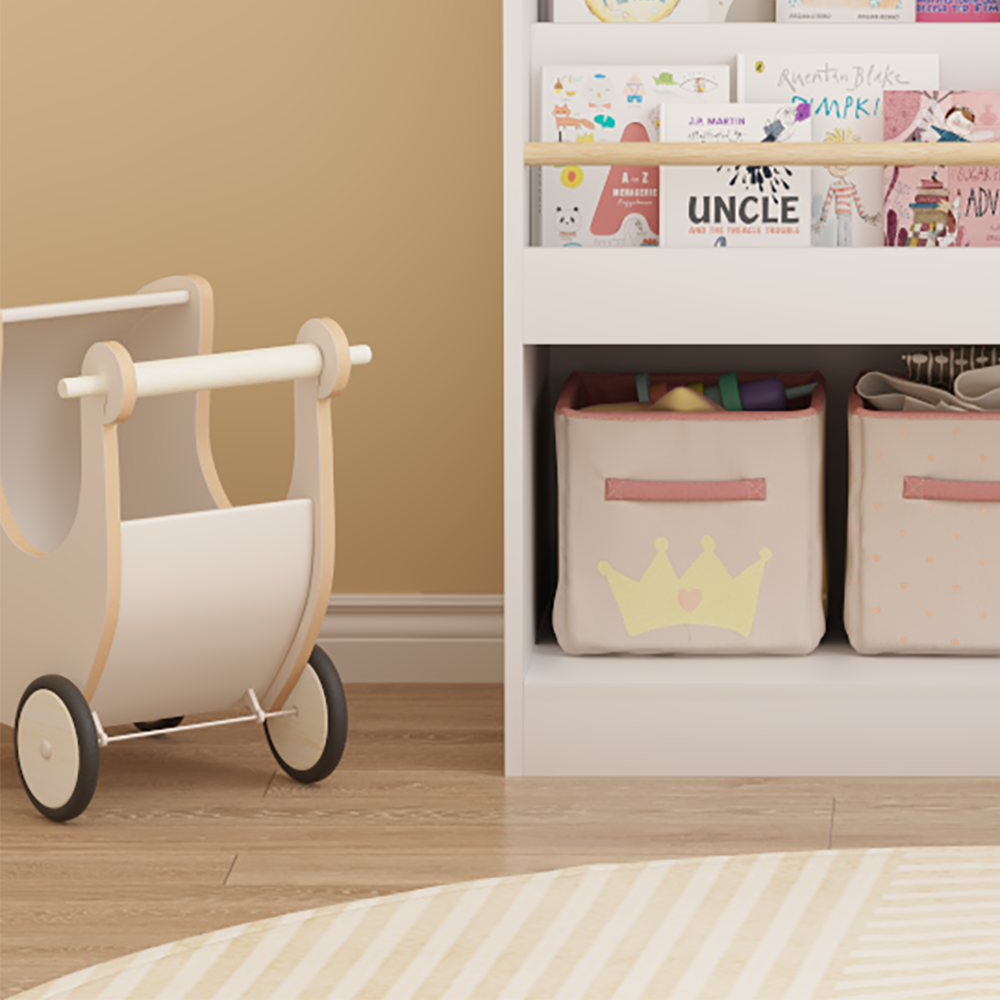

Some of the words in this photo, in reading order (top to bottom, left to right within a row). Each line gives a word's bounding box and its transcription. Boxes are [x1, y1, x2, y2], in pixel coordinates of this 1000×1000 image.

[845, 63, 911, 92] Blake
[707, 116, 746, 126] MARTIN
[621, 171, 629, 184] A
[642, 171, 649, 184] Z
[688, 196, 799, 224] UNCLE
[688, 226, 707, 235] AND
[709, 226, 724, 235] THE
